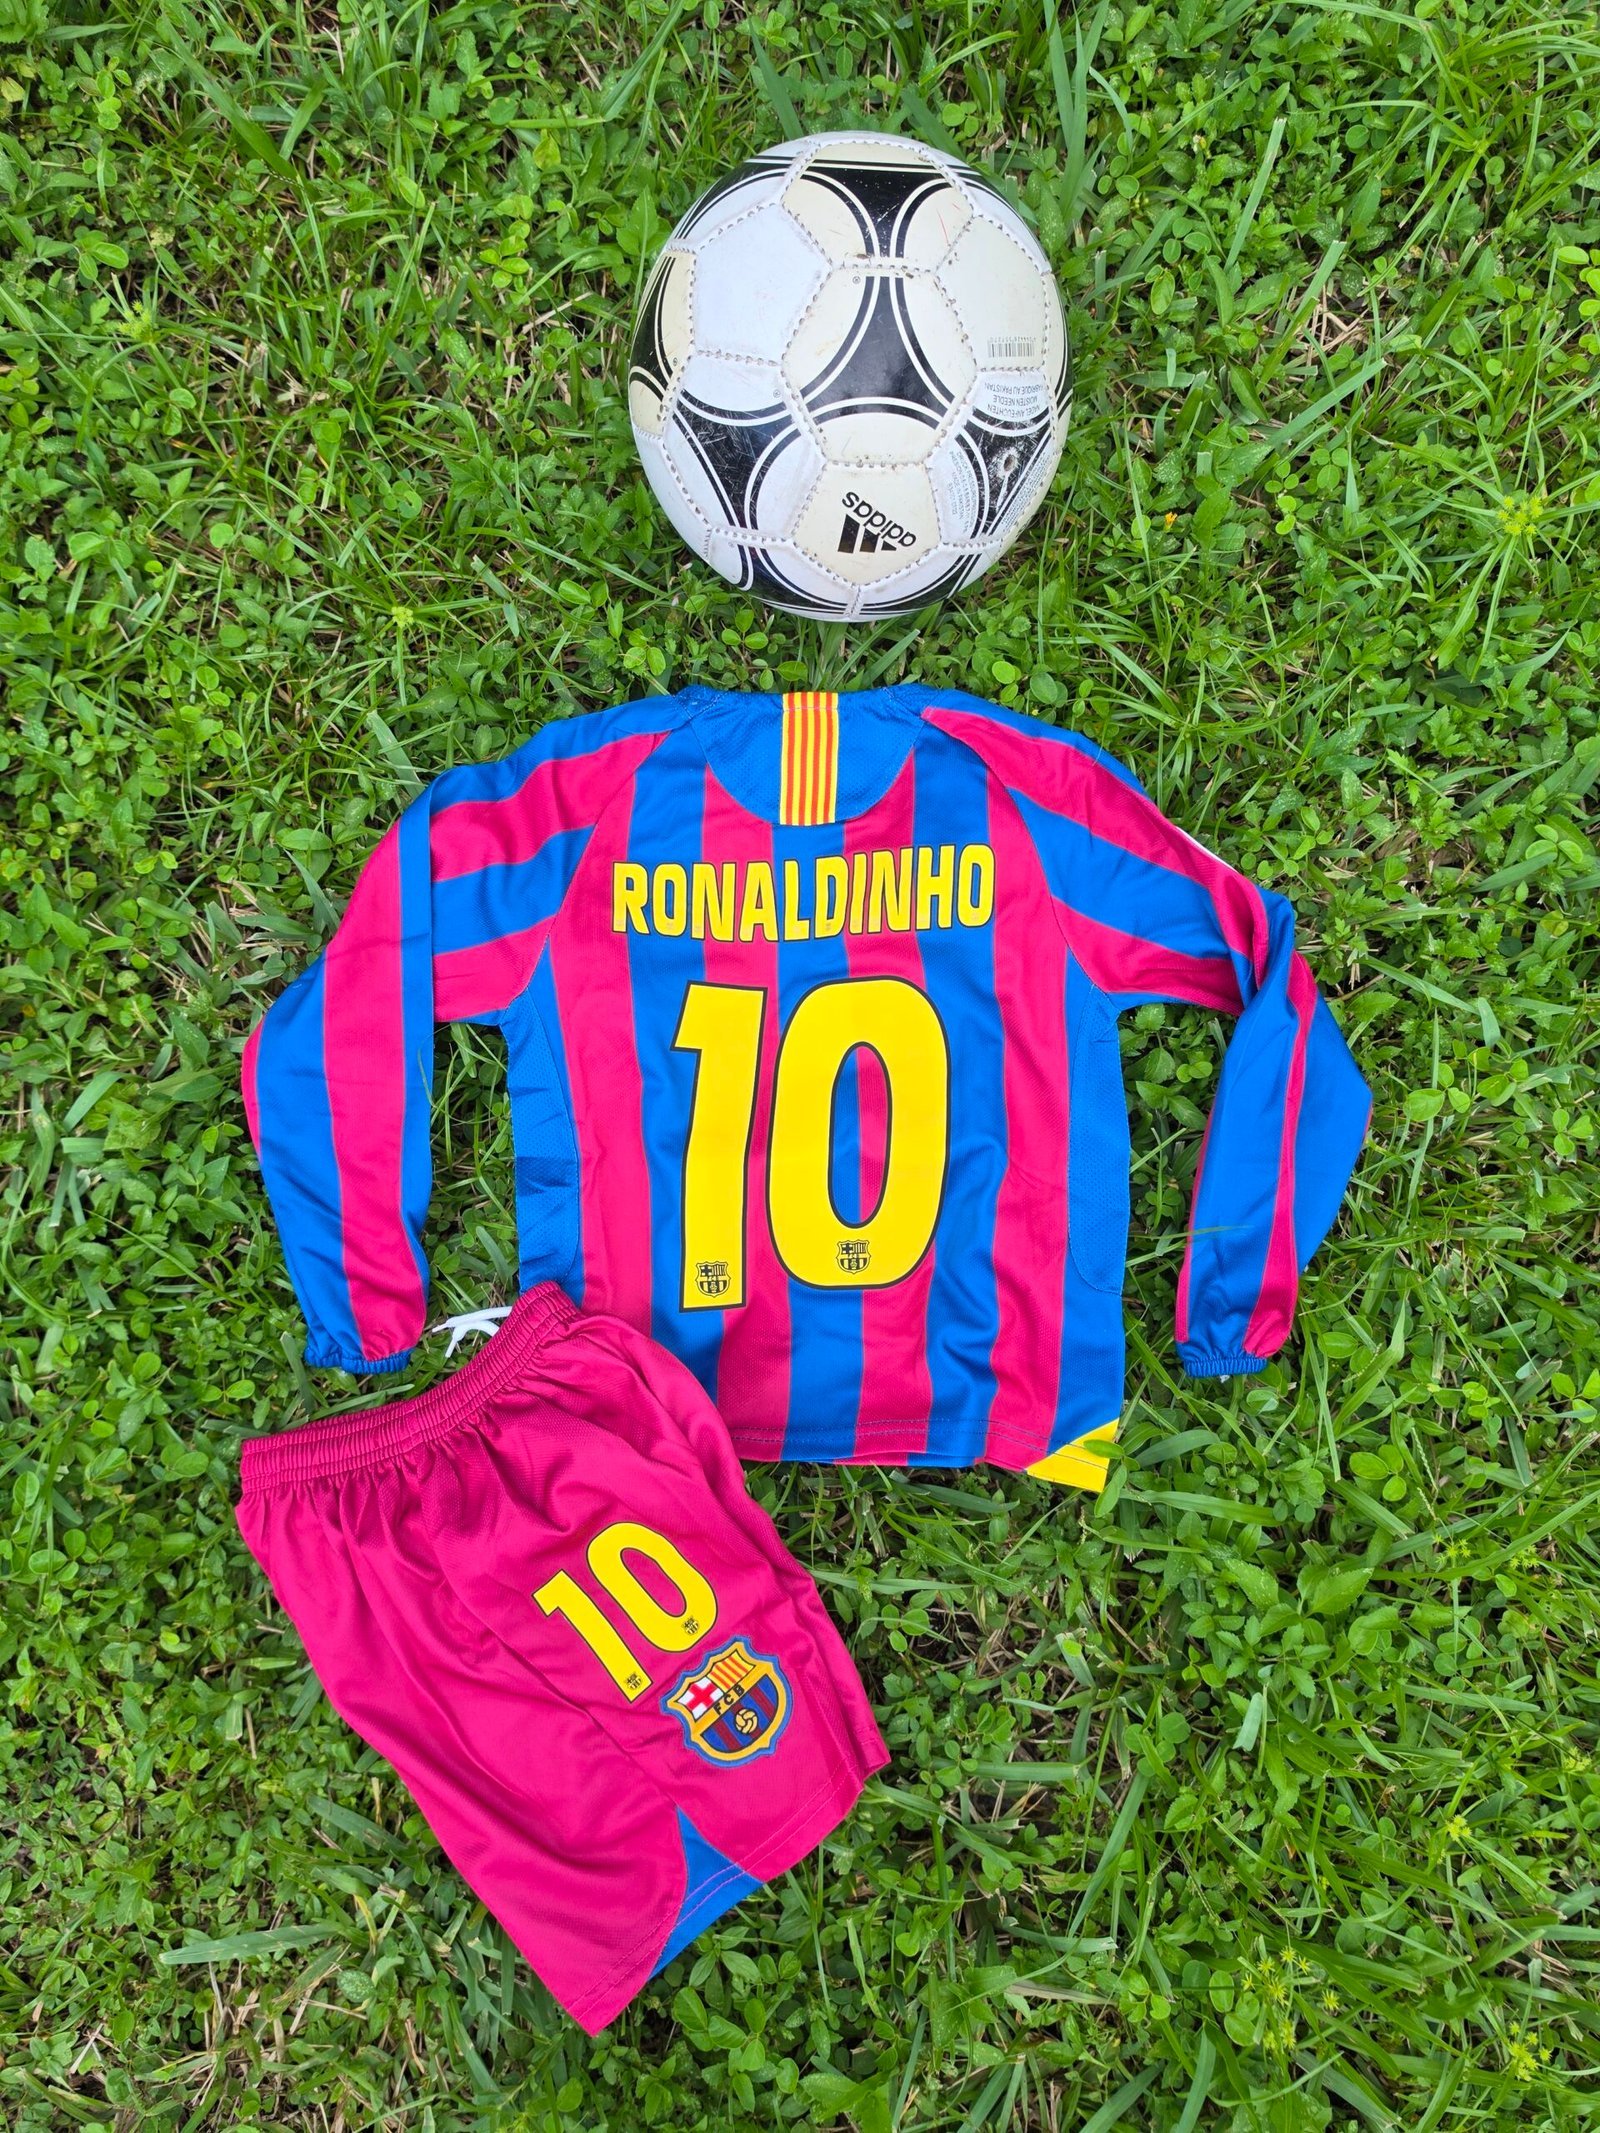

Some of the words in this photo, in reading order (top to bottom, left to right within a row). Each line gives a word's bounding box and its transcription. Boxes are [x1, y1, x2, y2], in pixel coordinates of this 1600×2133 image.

[993, 394, 1016, 406] NEEDLE
[841, 491, 917, 547] adidas
[611, 843, 995, 943] RONALDINHO
[669, 975, 952, 1313] 10
[531, 1521, 719, 1704] 10
